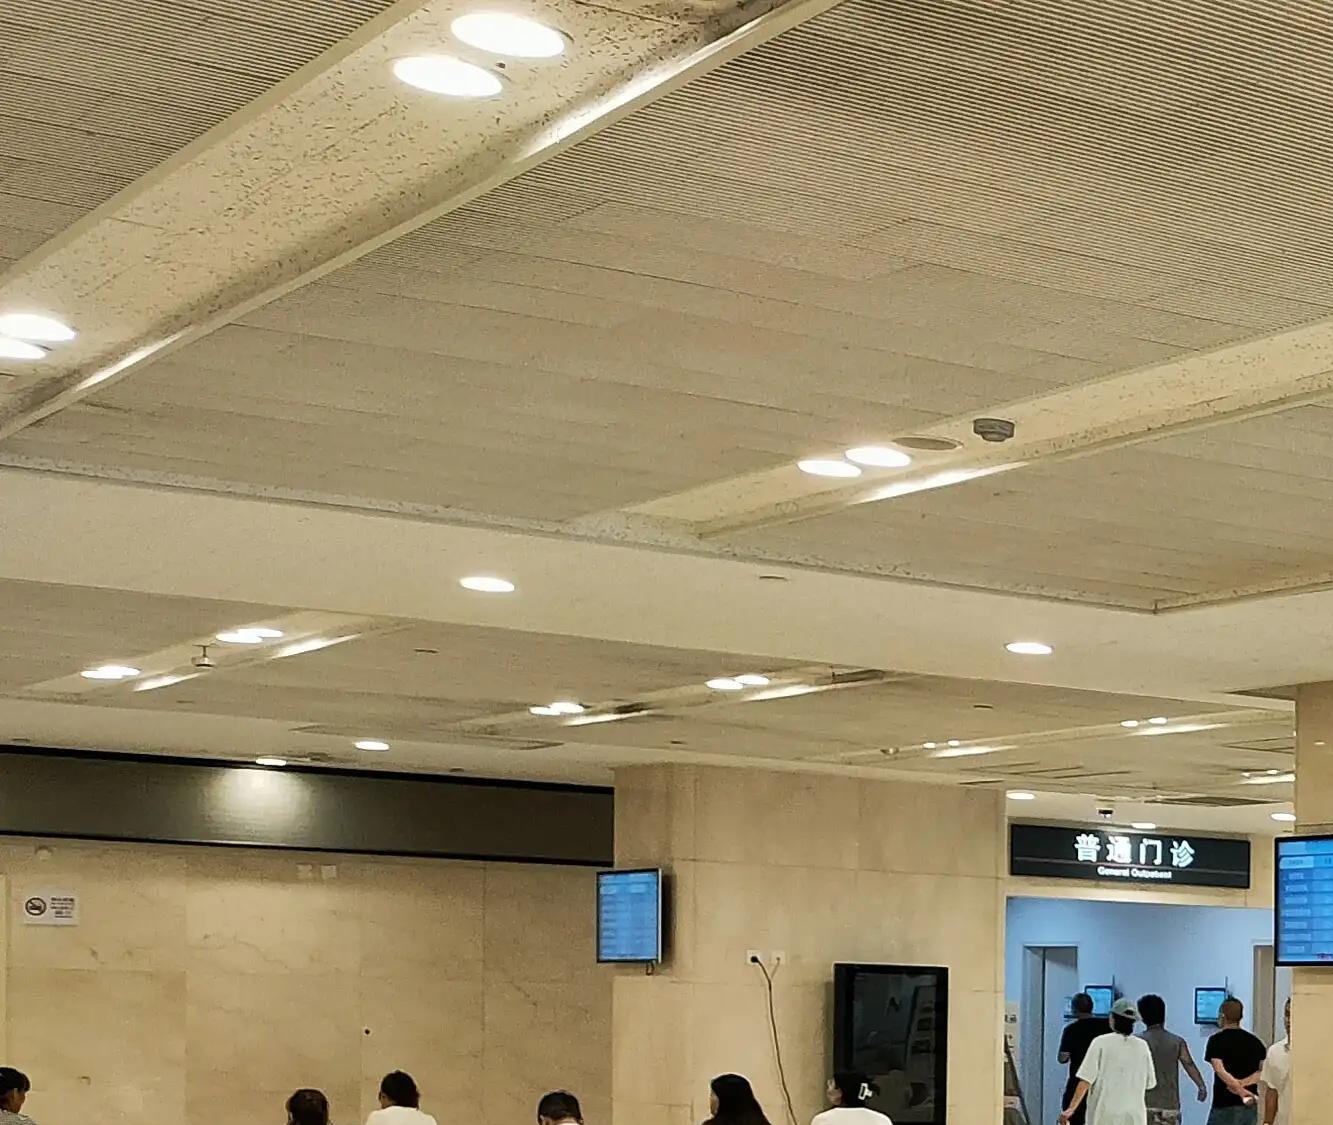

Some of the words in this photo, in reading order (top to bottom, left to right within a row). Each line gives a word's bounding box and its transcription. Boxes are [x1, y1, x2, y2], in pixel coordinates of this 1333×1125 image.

[1073, 833, 1196, 868] 普通门诊
[1097, 865, 1130, 877] General
